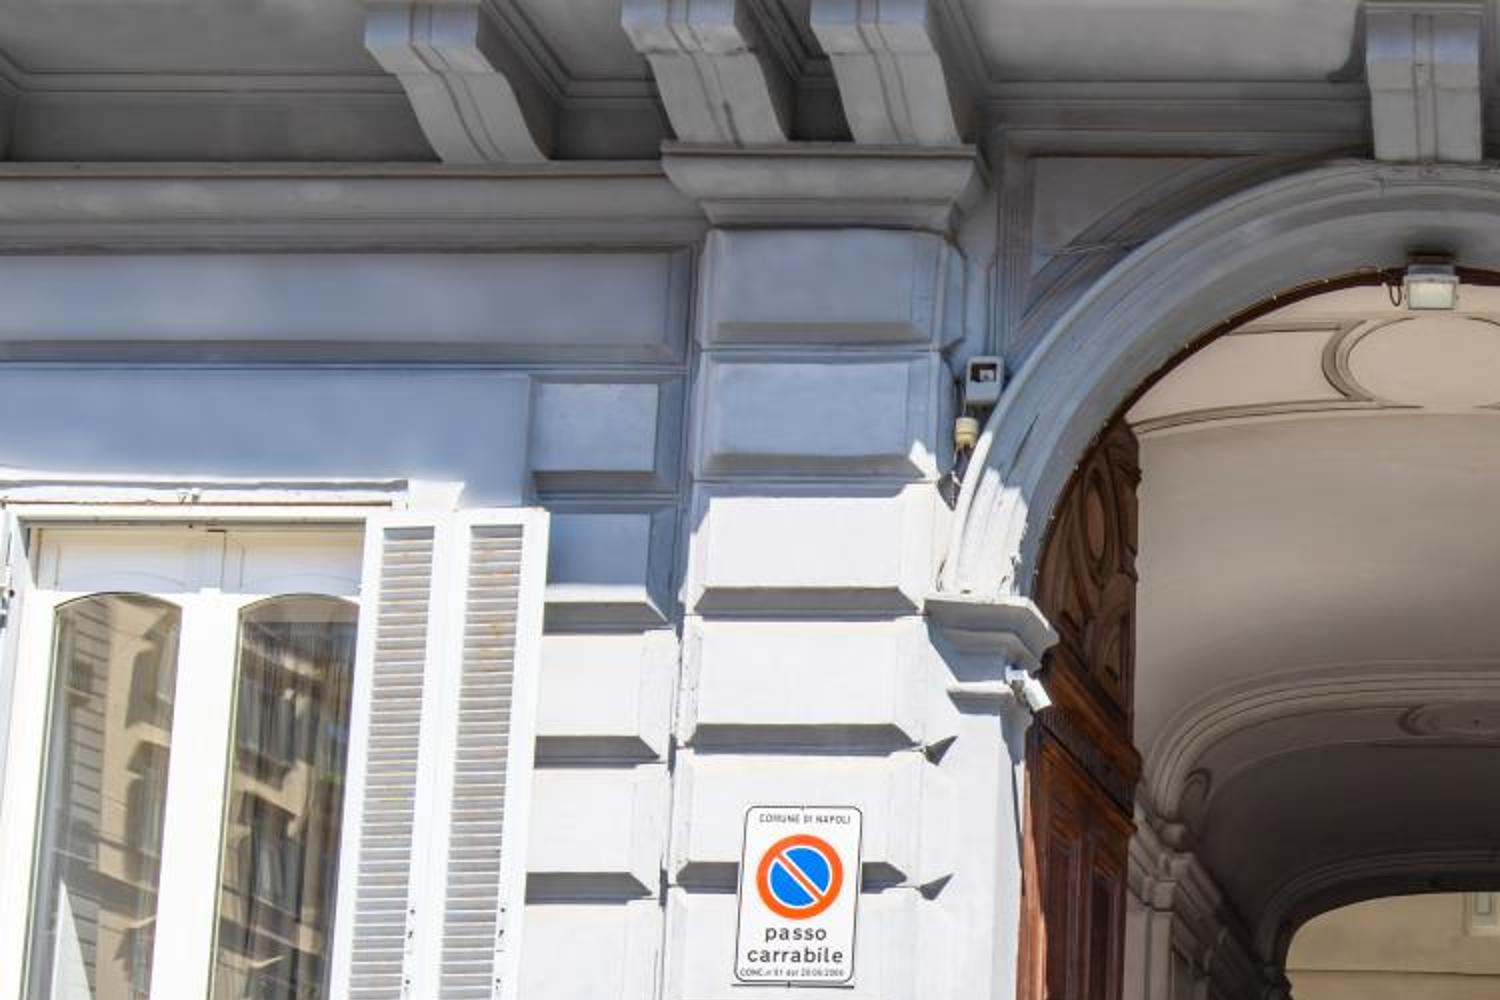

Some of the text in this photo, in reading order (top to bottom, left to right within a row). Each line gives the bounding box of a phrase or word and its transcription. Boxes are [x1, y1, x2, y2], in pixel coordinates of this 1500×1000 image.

[760, 813, 851, 826] COMUNE DI NAPOLI
[765, 927, 827, 942] passo
[747, 947, 843, 964] carrabile
